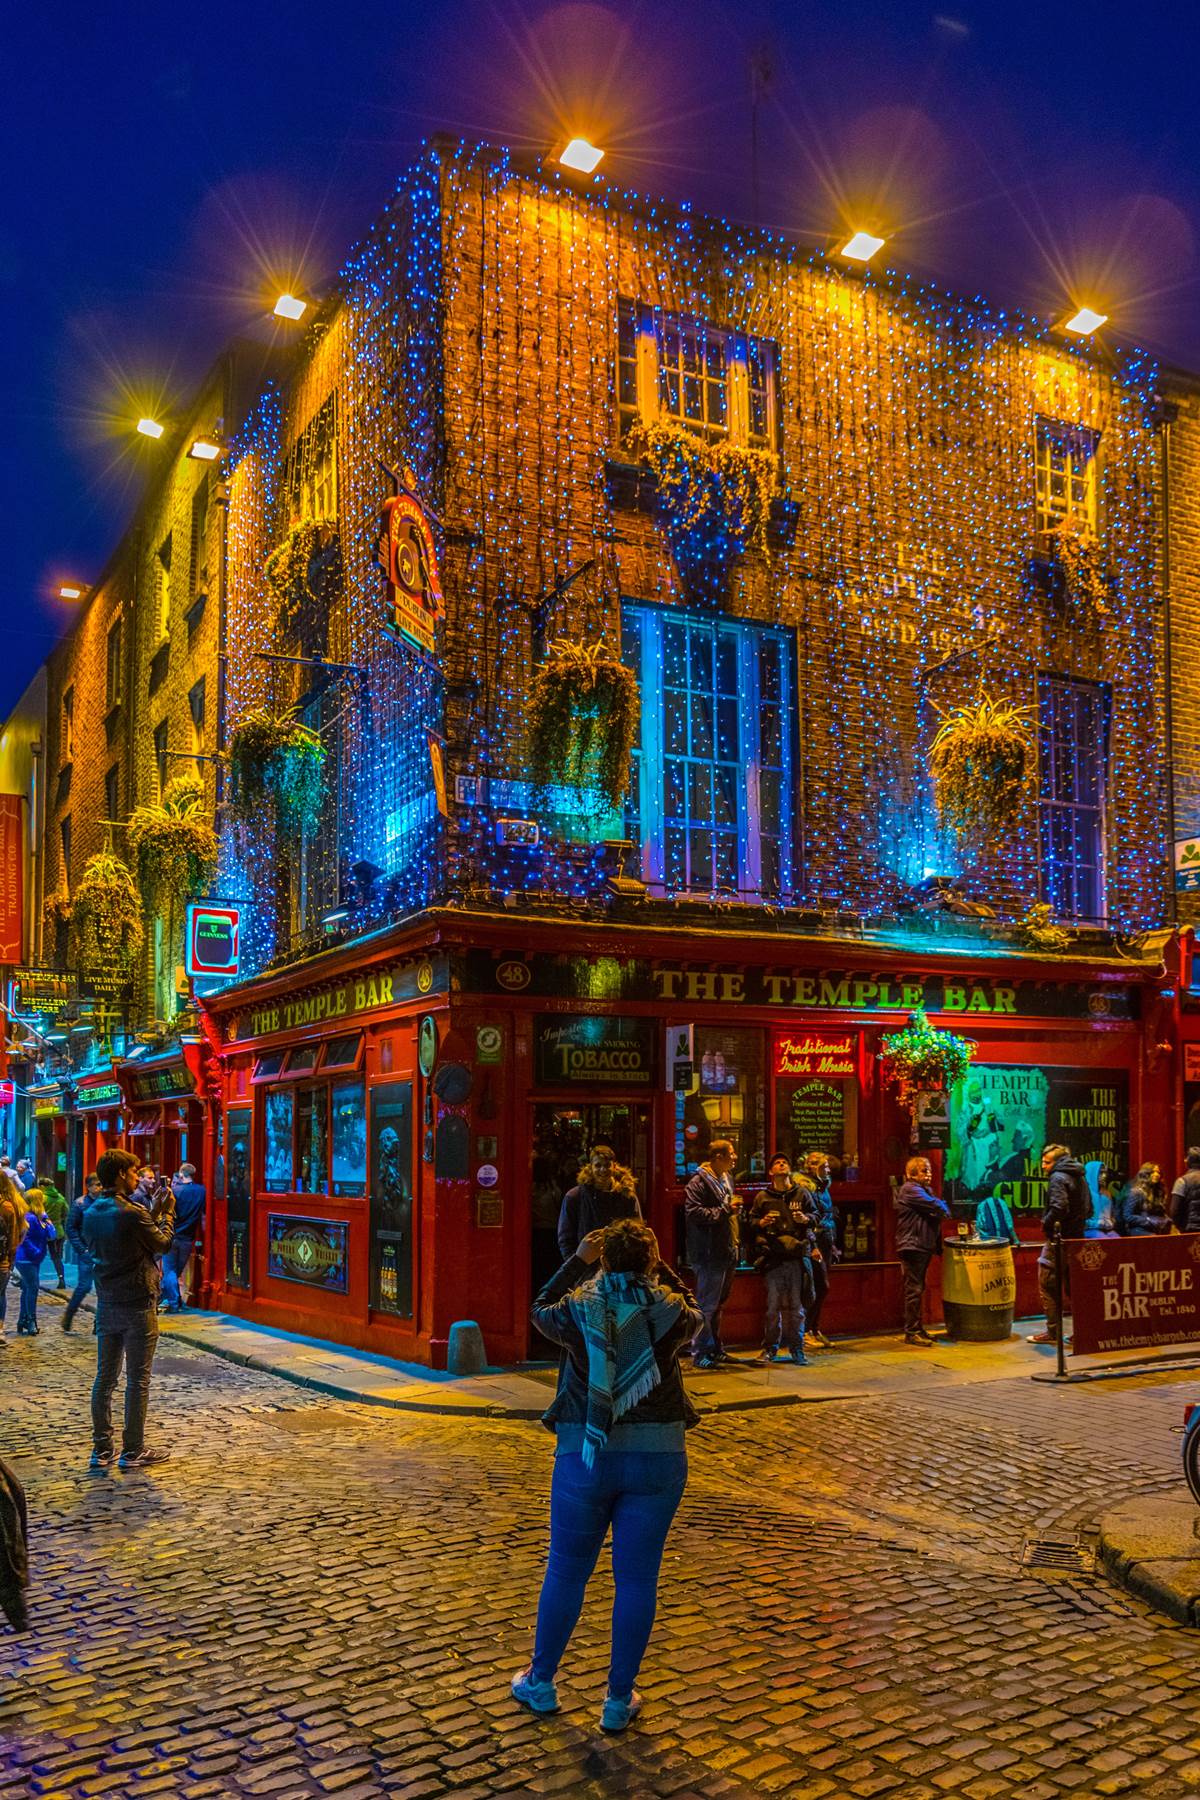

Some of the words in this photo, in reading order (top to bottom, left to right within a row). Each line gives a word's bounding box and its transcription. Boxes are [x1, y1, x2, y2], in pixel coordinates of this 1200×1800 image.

[402, 593, 427, 622] DUBLIN
[398, 612, 413, 631] LIVE
[412, 623, 432, 648] MUSIC
[8, 843, 17, 861] CO.
[8, 863, 17, 916] TRADING
[199, 931, 229, 940] GUINNESS
[14, 971, 30, 981] THE
[31, 972, 60, 982] TEMPLE
[61, 974, 77, 983] BAR
[84, 976, 103, 984] LIVE
[103, 977, 129, 985] MUSIC
[502, 966, 524, 983] 48
[653, 969, 746, 1001] THE
[763, 974, 925, 1010] TEMPLE
[942, 984, 1018, 1014] BAR
[22, 997, 69, 1007] DISTILLERY
[32, 1006, 60, 1014] STORE
[251, 1011, 280, 1036] THE
[284, 988, 347, 1027] TEMPLE
[354, 974, 394, 1011] BAR
[602, 1040, 641, 1049] SMOKING
[779, 1037, 851, 1055] Traditional
[555, 1043, 641, 1076] TOBACCO
[778, 1055, 811, 1073] Irish
[816, 1056, 855, 1073] Music
[981, 1074, 1043, 1090] TEMPLE
[792, 1083, 825, 1100] TEMPLE
[827, 1085, 843, 1102] BAR
[1000, 1090, 1031, 1107] BAR
[1090, 1088, 1117, 1107] THE
[1060, 1108, 1116, 1128] EMPEROR
[1102, 1130, 1116, 1149] OF
[984, 1275, 1015, 1293] JAMESO
[1102, 1275, 1118, 1286] THE
[1117, 1262, 1193, 1295] TEMPLE
[1103, 1288, 1151, 1321] BAR
[1150, 1295, 1177, 1307] DUBLIN
[1177, 1304, 1196, 1314] 1840
